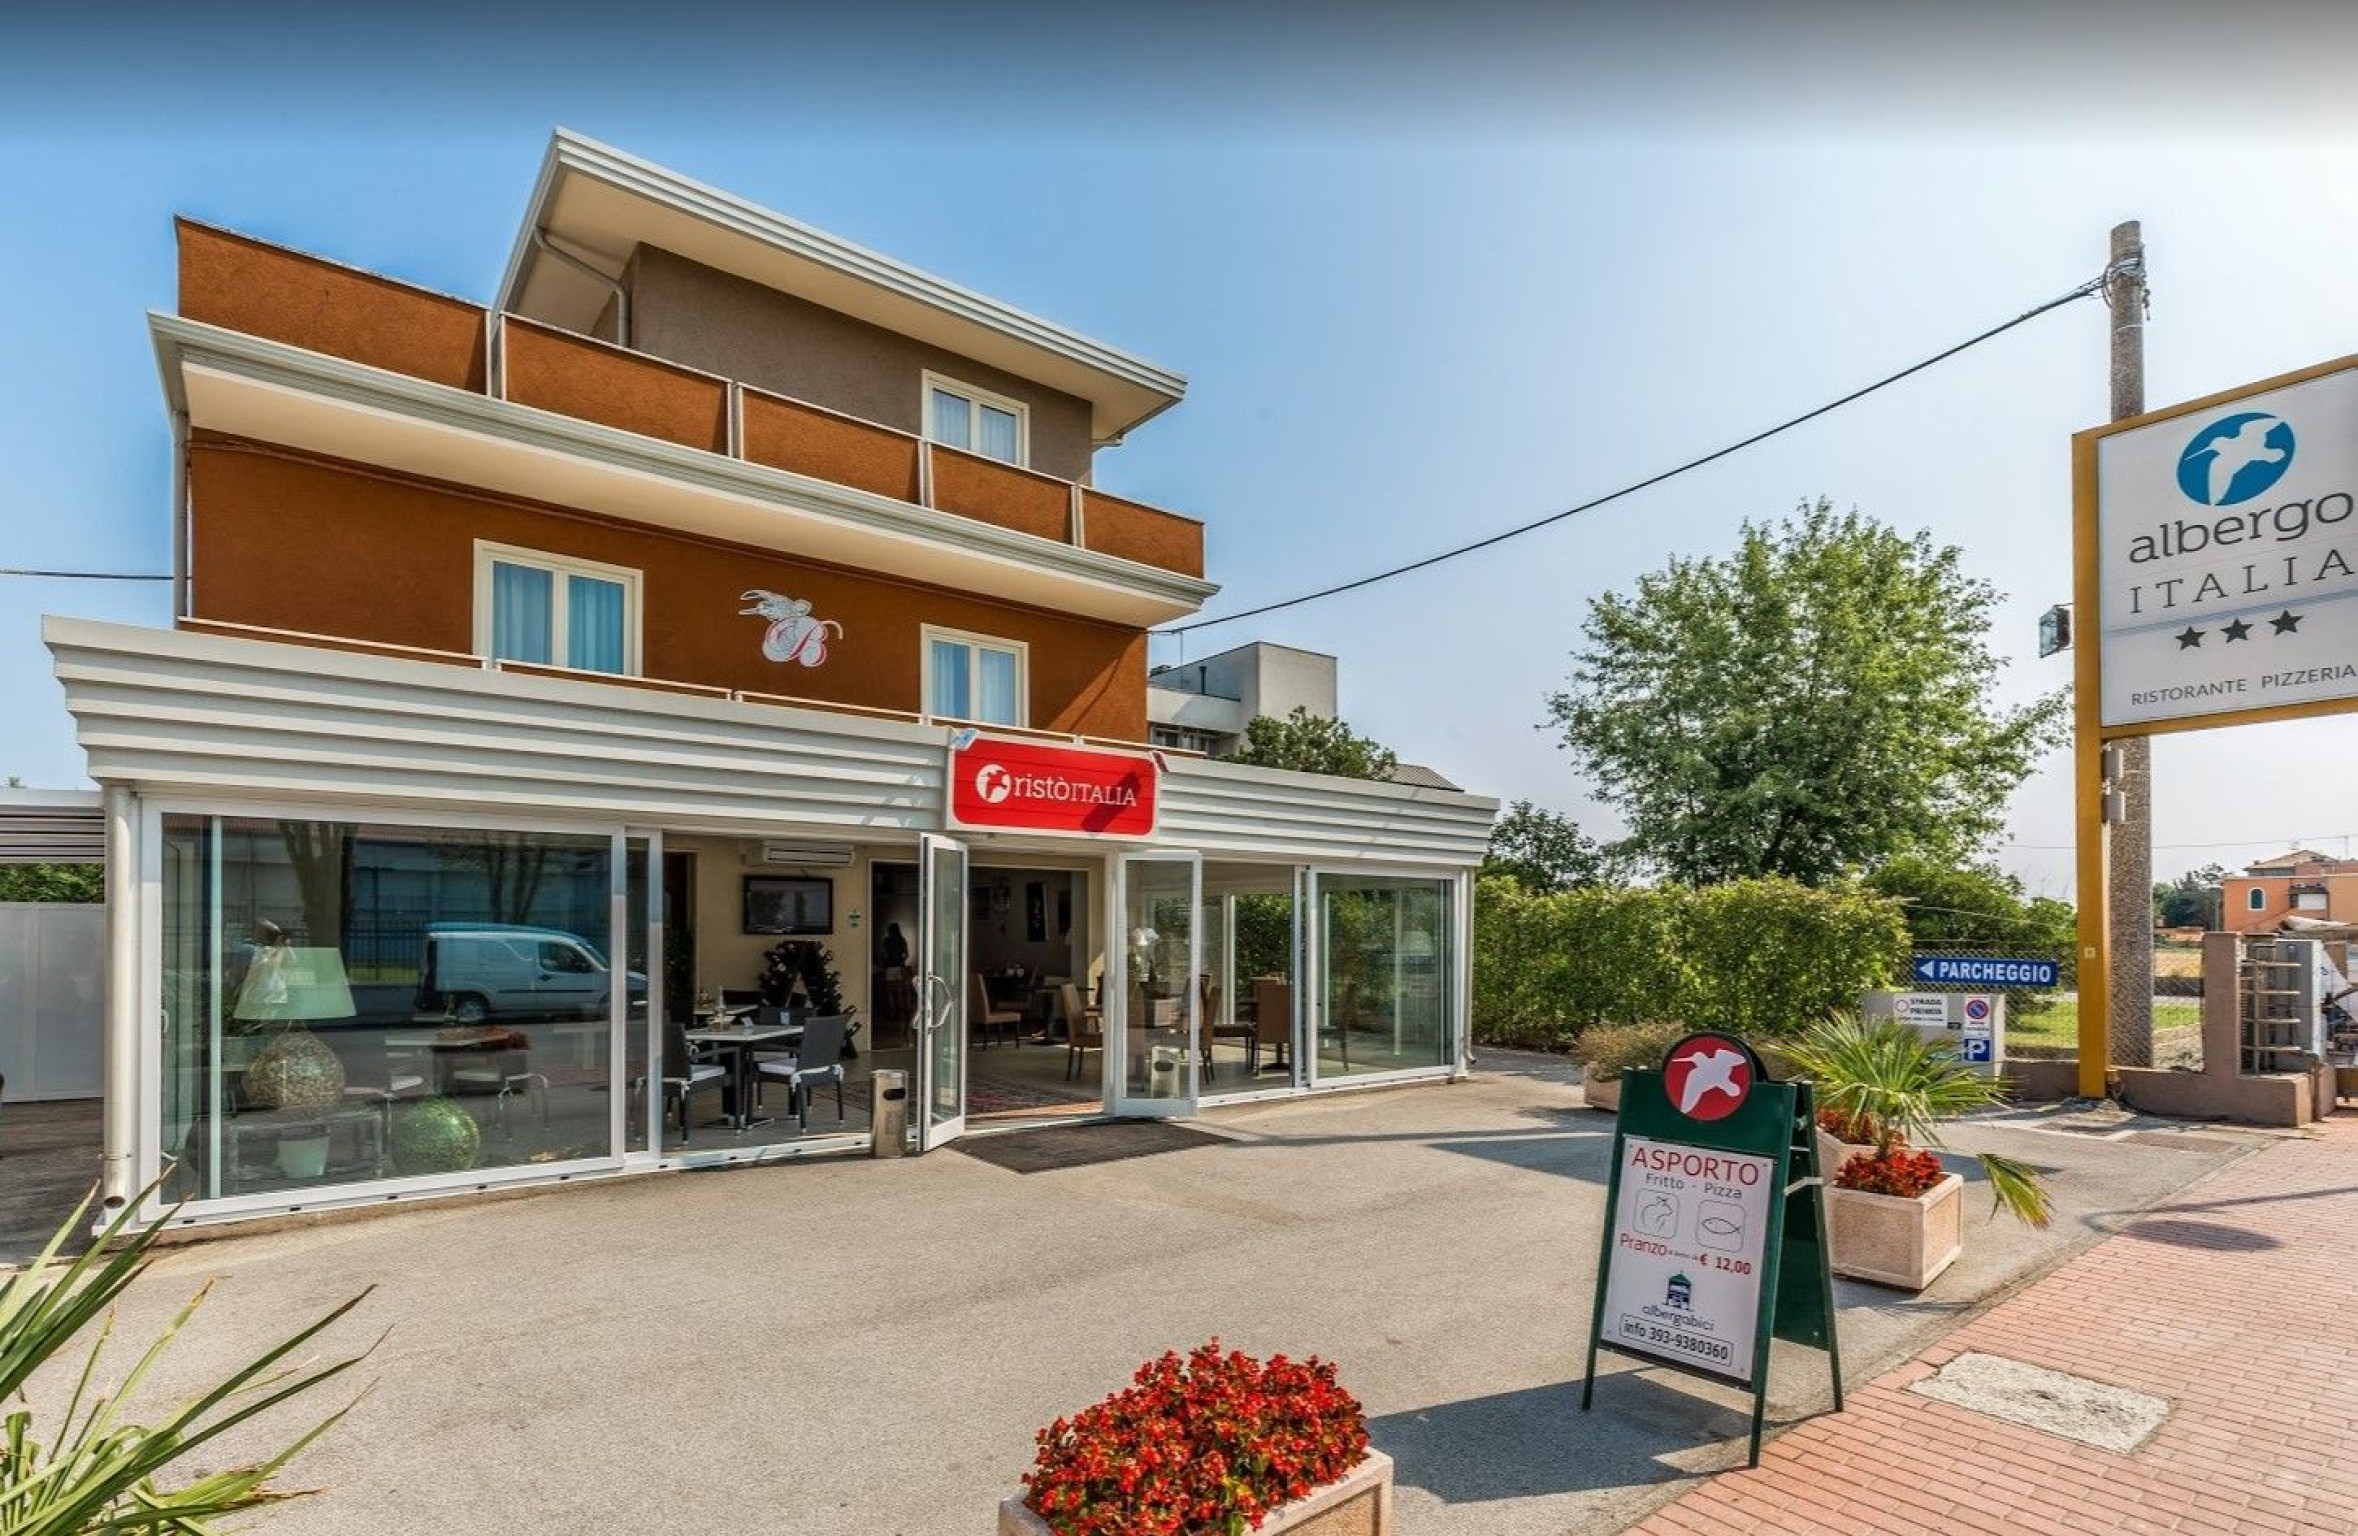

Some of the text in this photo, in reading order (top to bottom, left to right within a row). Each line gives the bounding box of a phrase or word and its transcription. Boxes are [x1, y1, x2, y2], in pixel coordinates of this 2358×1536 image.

[2129, 491, 2354, 564] albergo
[2130, 548, 2355, 614] ITALIA
[2131, 663, 2358, 706] RISTORANTE PIZZERIA
[1938, 960, 2052, 983] PARCHEGGIO
[1630, 1147, 1759, 1186] ASPORTO
[1645, 1172, 1685, 1190] Fritto
[1703, 1181, 1743, 1199] Pizza
[1619, 1233, 1668, 1257] Pranzo
[1623, 1319, 1728, 1360] info 393-9380360
